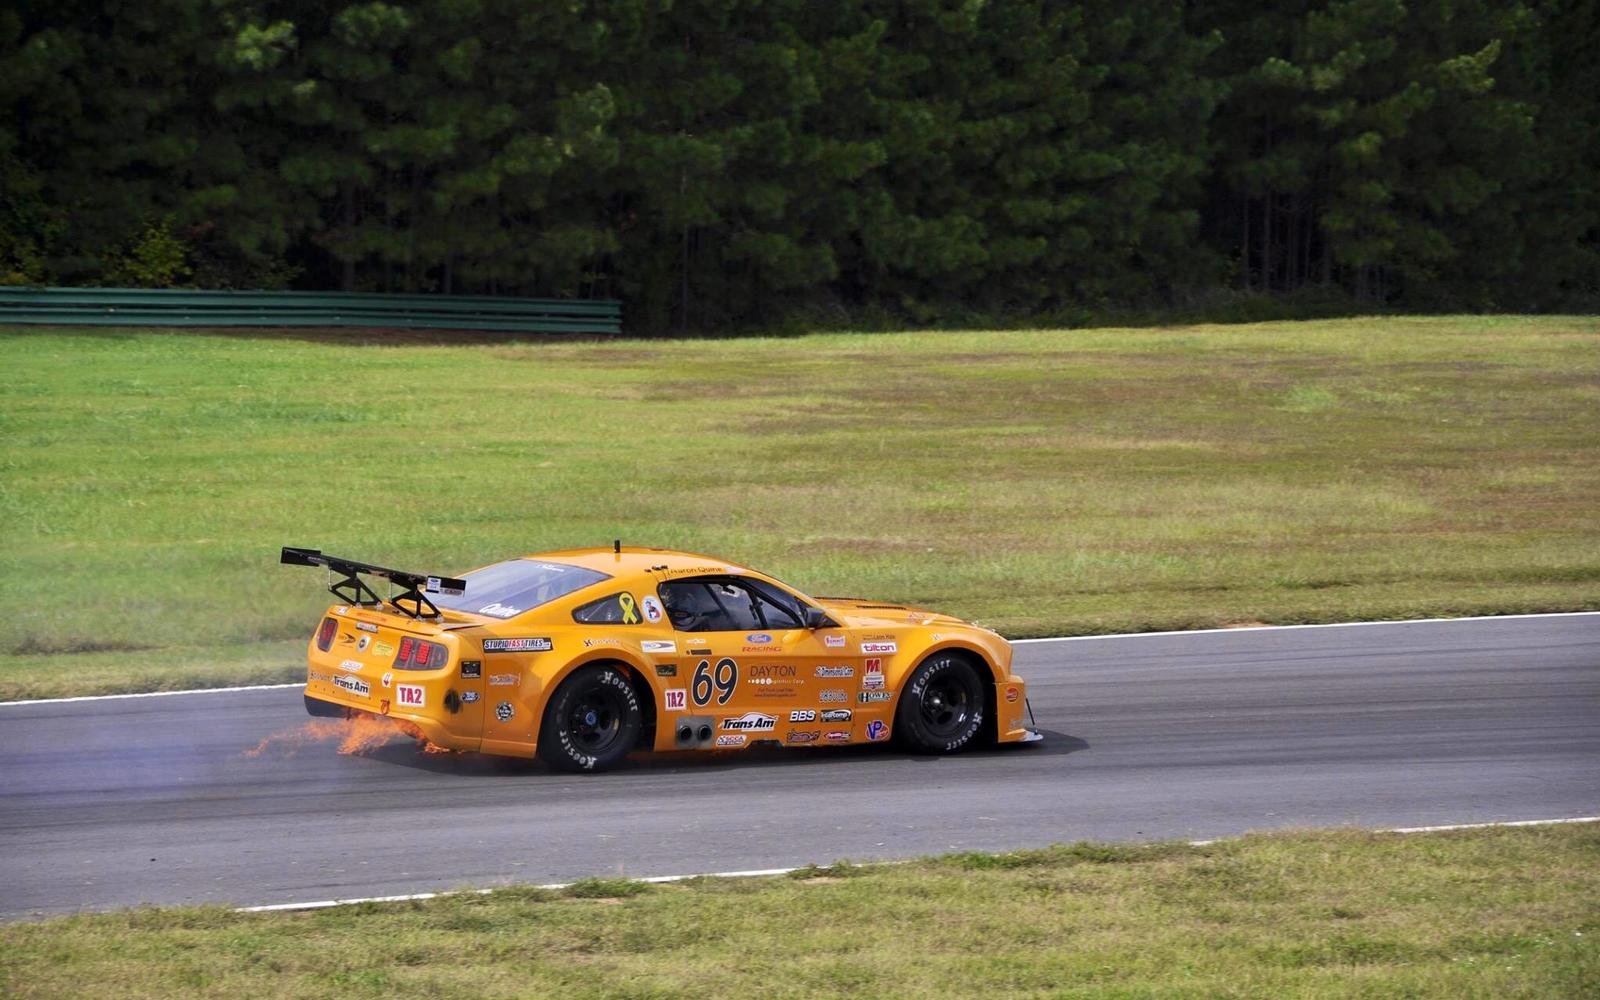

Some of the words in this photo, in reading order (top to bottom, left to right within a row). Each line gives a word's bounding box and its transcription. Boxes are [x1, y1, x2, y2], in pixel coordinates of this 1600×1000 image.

[863, 644, 895, 653] tilton
[750, 665, 797, 677] DAYTON
[912, 659, 951, 697] Hoosier
[334, 676, 354, 690] Trans
[354, 681, 369, 694] Am
[691, 657, 739, 707] 69
[399, 687, 423, 704] TA2
[601, 671, 638, 711] Hoosier
[666, 691, 684, 708] TA2
[723, 719, 754, 729] Trans
[754, 718, 775, 728] Am
[790, 710, 816, 722] BBS
[946, 711, 984, 751] Hoosier
[559, 730, 598, 769] Hoosier
